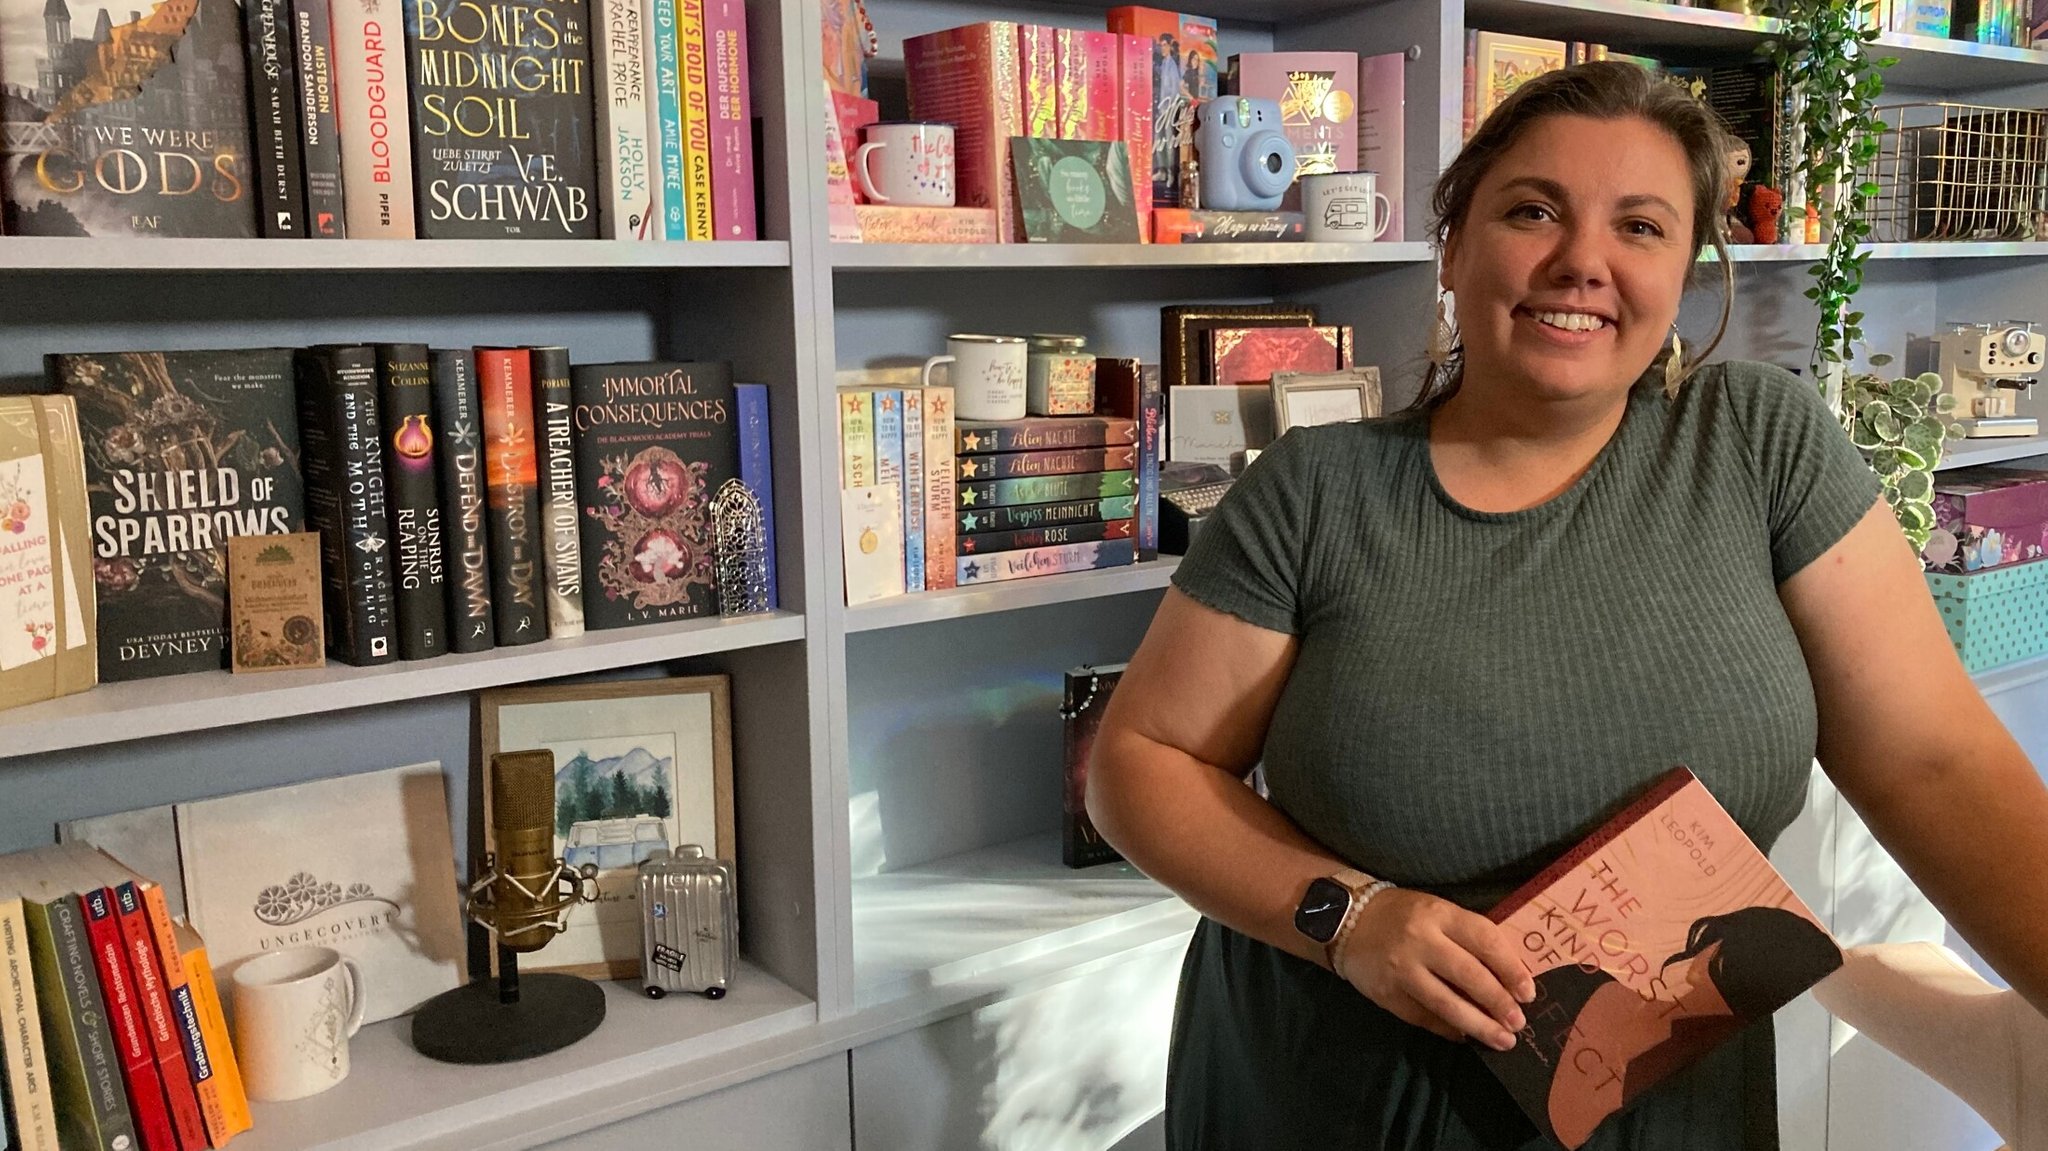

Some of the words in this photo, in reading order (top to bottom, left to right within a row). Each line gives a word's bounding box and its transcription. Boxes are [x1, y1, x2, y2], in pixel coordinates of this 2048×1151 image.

[299, 11, 313, 72] BRANDON
[418, 0, 559, 50] BONES
[563, 31, 583, 45] the
[567, 18, 578, 31] in
[609, 0, 627, 59] RACHEL
[659, 33, 674, 63] YOUR
[314, 45, 330, 113] MISTBORN
[421, 49, 584, 94] MIDNIGHT
[626, 9, 642, 102] REAPPEARANCE
[685, 42, 704, 85] BOLD
[715, 29, 730, 89] AUFSTAND
[727, 29, 741, 93] HORMONE
[270, 87, 281, 124] SARAH
[363, 21, 391, 183] BLOODGUARD
[612, 62, 628, 109] PRICE
[661, 67, 676, 106] ART
[688, 91, 704, 116] OF
[719, 93, 730, 120] DER
[730, 94, 741, 121] DER
[304, 74, 319, 145] SANDERSON
[423, 94, 530, 140] SOIL
[95, 126, 134, 146] WE
[141, 127, 214, 151] WERE
[273, 129, 284, 159] BETH
[464, 149, 502, 161] STIRBT
[664, 119, 678, 149] AMIE
[688, 118, 706, 152] YOU
[35, 149, 244, 201] GODS
[276, 164, 288, 200] DURST
[443, 161, 493, 174] ZULETZT
[618, 127, 633, 201] JACKSON
[631, 138, 645, 190] HOLLY
[694, 155, 706, 189] CASE
[378, 193, 390, 226] PIPER
[430, 179, 589, 233] SCHWAB
[695, 192, 709, 240] KENNY
[455, 359, 467, 420] KEMMERER
[504, 358, 515, 418] KEMMERER
[546, 402, 569, 414] A
[605, 369, 698, 404] IMMORTAL
[575, 399, 727, 431] CONSEQUENCES
[655, 432, 688, 441] ACADEMY
[364, 436, 386, 519] KNIGHT
[547, 416, 575, 510] TREACHERY
[852, 455, 863, 488] ASCH
[112, 466, 240, 514] SHIELD
[252, 477, 274, 503] OF
[347, 460, 368, 530] MOTH
[456, 447, 482, 532] DEFEND
[500, 449, 528, 543] DESTROY
[909, 451, 920, 531] WINTERROSE
[931, 470, 940, 512] STURM
[940, 459, 951, 520] VEILCHEN
[95, 506, 290, 559] SPARROWS
[417, 526, 428, 544] ON
[553, 514, 576, 535] OF
[1006, 507, 1044, 527] Vergiss
[1045, 503, 1095, 521] MEINNICHT
[1044, 528, 1068, 543] ROSE
[398, 509, 420, 590] REAPING
[419, 549, 429, 570] THE
[426, 508, 443, 585] SUNRISE
[555, 542, 580, 598] SWANS
[1008, 552, 1050, 575] Veilchen
[1052, 551, 1080, 566] STURM
[18, 585, 32, 596] AT
[37, 581, 46, 592] A
[363, 562, 377, 624] GILLIG
[375, 556, 389, 627] RACHEL
[462, 545, 491, 617] DAWN
[659, 604, 699, 617] MARIE
[119, 636, 212, 662] DEVNEY
[148, 632, 178, 642] TODAY
[1660, 814, 1717, 878] LEOPOLD
[1689, 819, 1714, 851] KIM
[1591, 860, 1642, 920] THE
[4, 918, 16, 958] WRITING
[260, 911, 392, 950] UNGECOVERT
[656, 945, 686, 961] FRAGILE
[1522, 930, 1564, 965] OF
[1539, 907, 1602, 975] KIND
[1570, 888, 1687, 1020] WORST
[9, 958, 23, 1015] ARCHETYPAL
[105, 943, 127, 1004] Rechtsmedizin
[135, 939, 159, 994] Mythologie
[59, 908, 81, 964] CRAFTING
[73, 964, 92, 1009] NOVELS
[88, 1030, 106, 1065] SHORT
[97, 1065, 117, 1113] STORIES
[122, 1003, 142, 1059] Grundwissen
[150, 993, 169, 1043] Griechische
[17, 1017, 33, 1069] CHARACTER
[177, 989, 209, 1080] Grabungstechnik
[26, 1067, 37, 1095] ARCS
